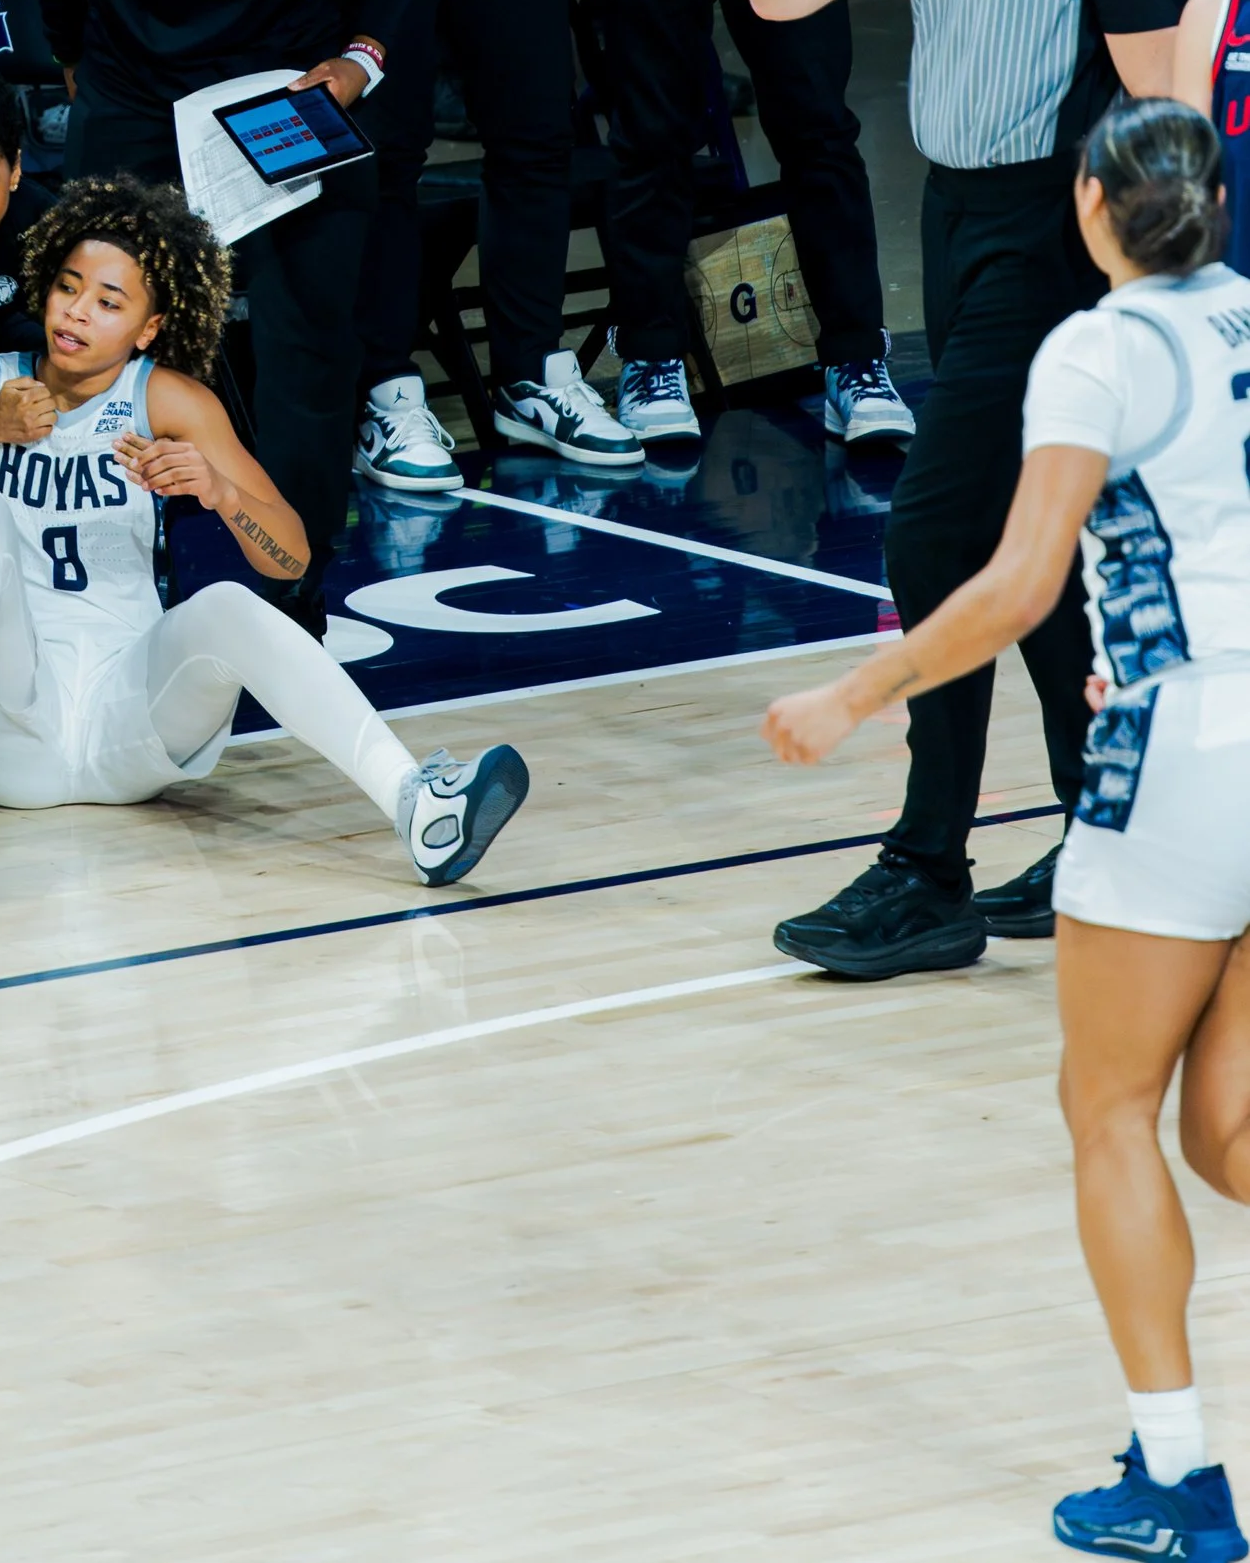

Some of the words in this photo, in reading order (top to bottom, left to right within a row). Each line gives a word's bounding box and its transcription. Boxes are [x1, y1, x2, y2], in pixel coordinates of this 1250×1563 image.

[730, 282, 758, 324] G
[94, 423, 124, 433] EAST
[98, 418, 119, 426] BIG
[42, 525, 88, 592] 8
